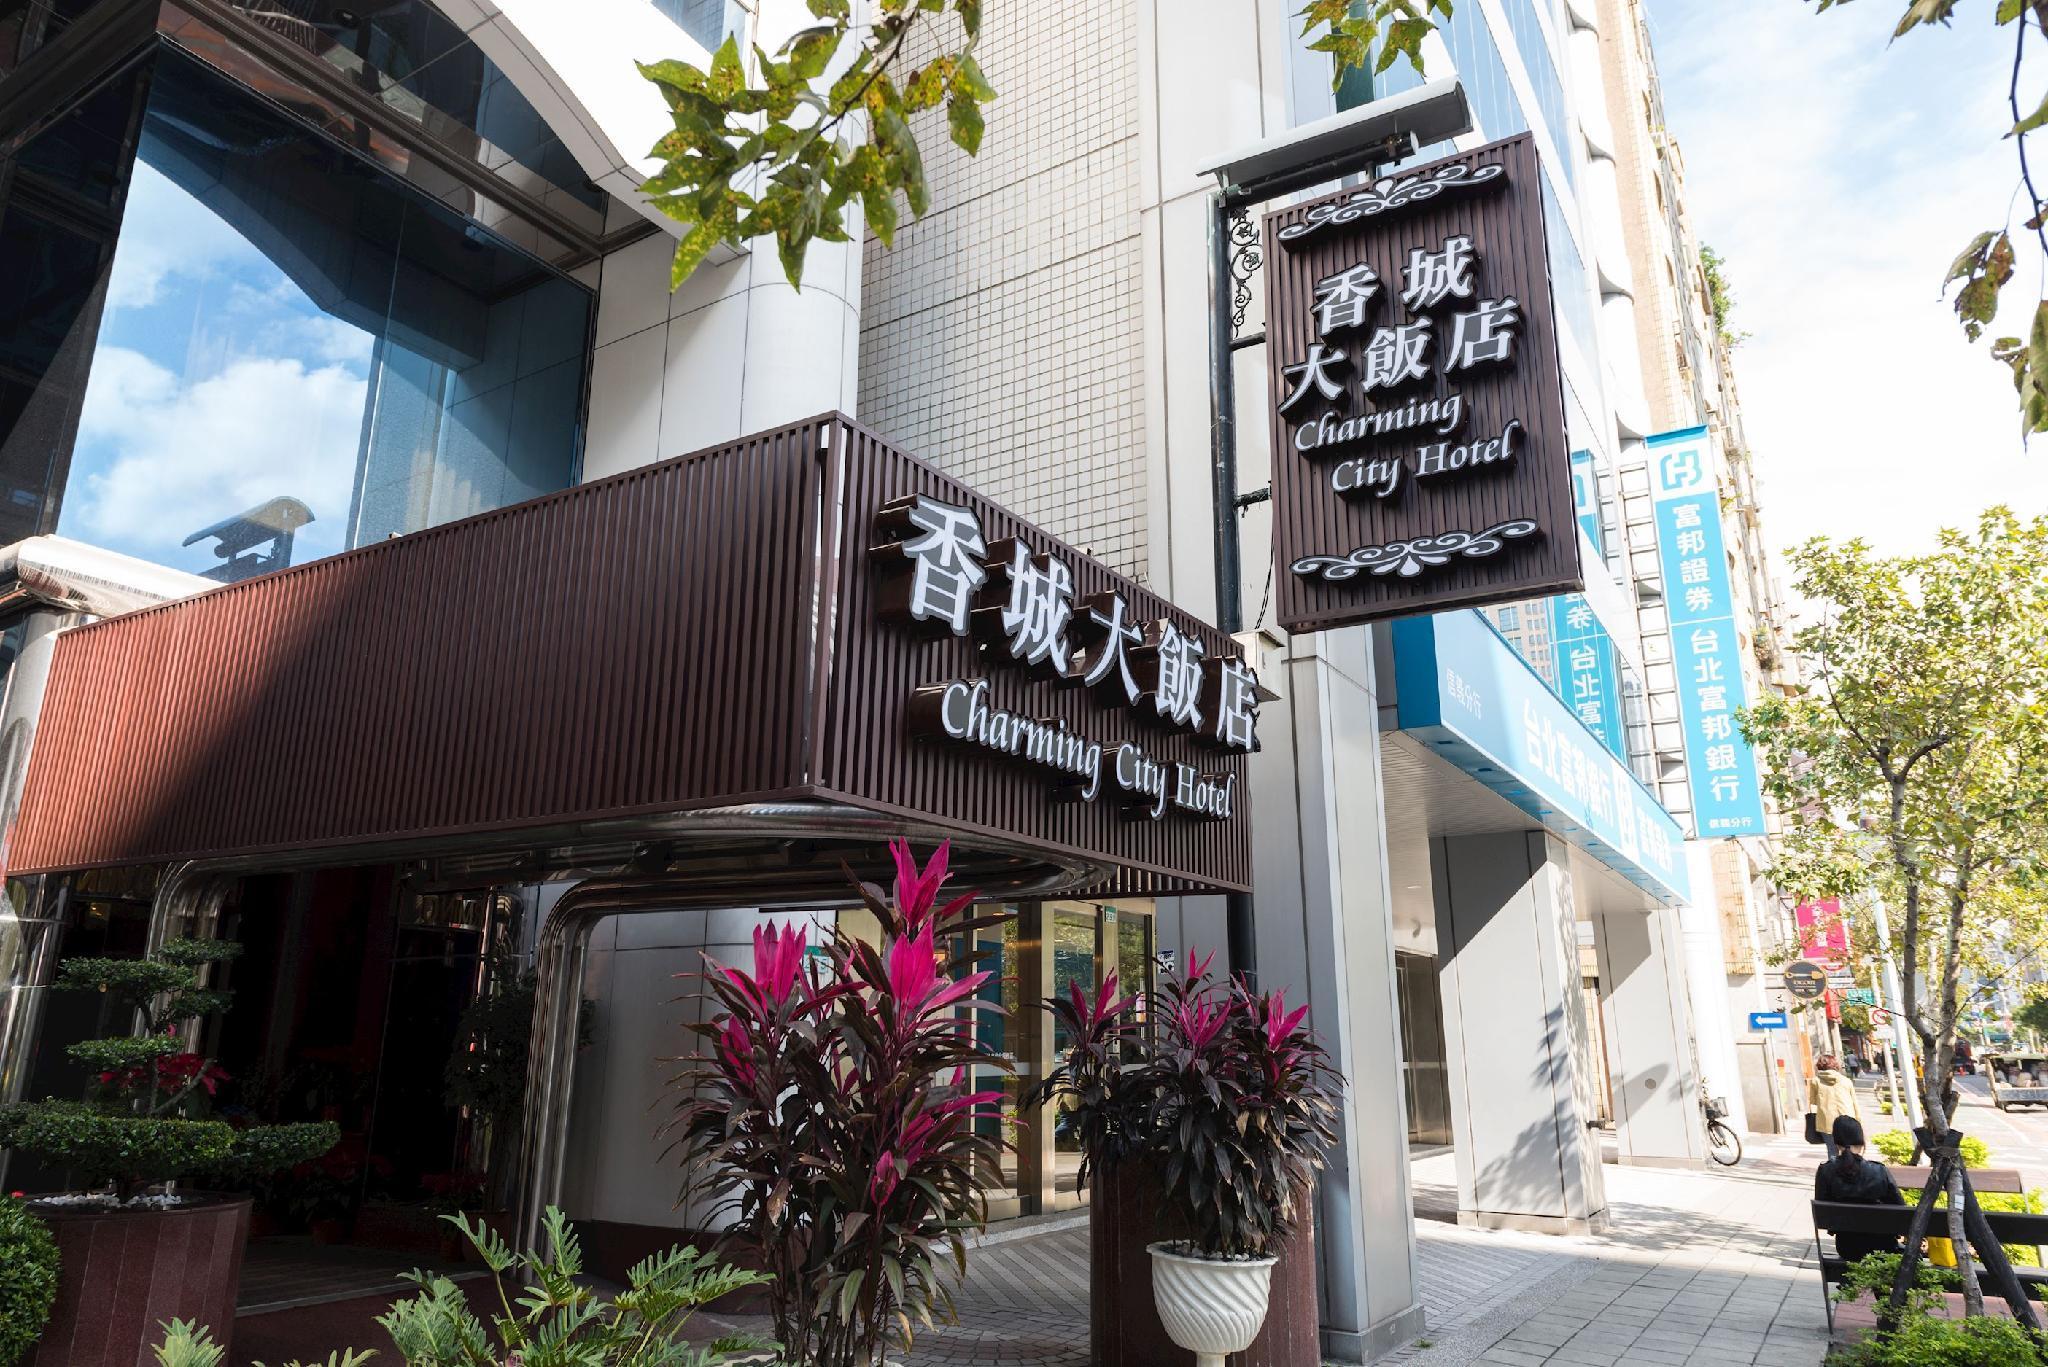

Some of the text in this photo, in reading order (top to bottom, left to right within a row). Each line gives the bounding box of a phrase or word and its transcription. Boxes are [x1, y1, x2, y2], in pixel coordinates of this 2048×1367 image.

[1312, 236, 1475, 335] 香城
[1278, 298, 1520, 414] 大飯店
[1294, 393, 1462, 452] Charming
[1331, 420, 1520, 498] City Hotel
[1671, 503, 1714, 611] 富邦證券
[902, 498, 1260, 752] 香城大飯店
[941, 679, 1236, 819] Charming City Hotel
[1690, 628, 1740, 802] 台北富邦銀行
